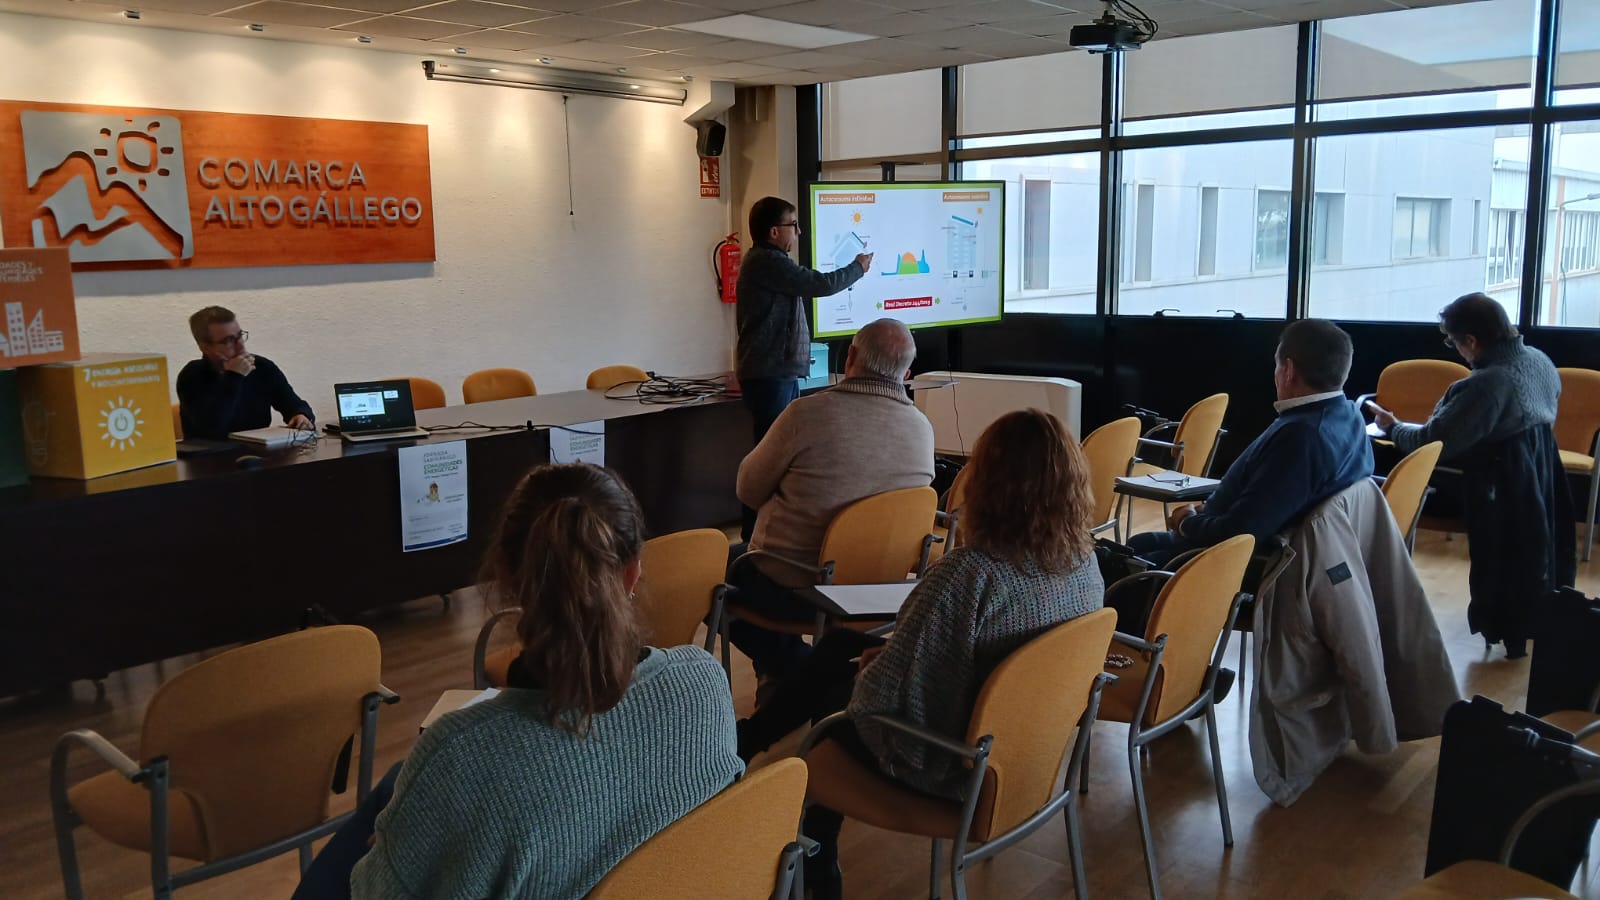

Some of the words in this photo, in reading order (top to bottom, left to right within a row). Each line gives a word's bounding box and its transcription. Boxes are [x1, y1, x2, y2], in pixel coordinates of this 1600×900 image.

[199, 156, 368, 188] COMARCA
[204, 194, 285, 222] ALTO
[288, 190, 424, 222] GÁLLEGO
[83, 367, 91, 382] 7
[424, 459, 463, 470] COMUNIDADES
